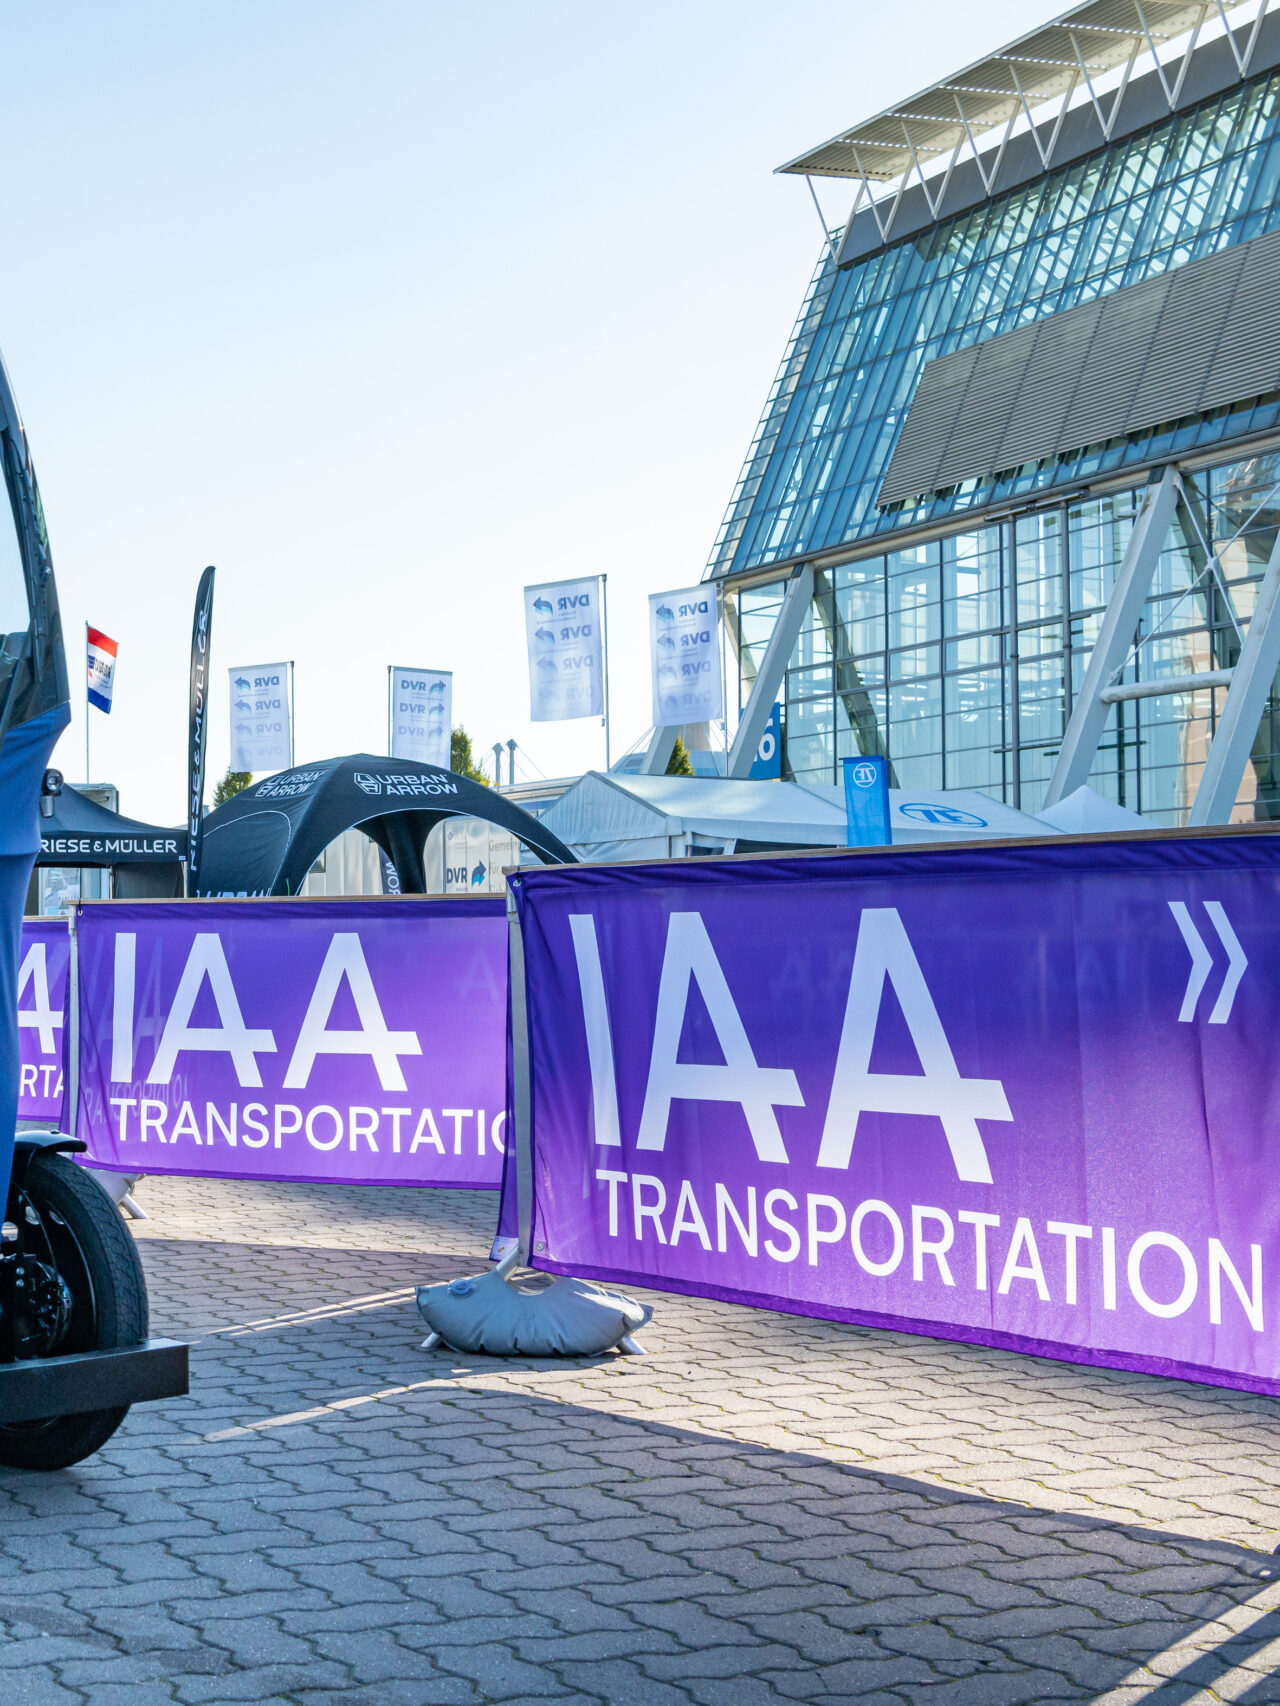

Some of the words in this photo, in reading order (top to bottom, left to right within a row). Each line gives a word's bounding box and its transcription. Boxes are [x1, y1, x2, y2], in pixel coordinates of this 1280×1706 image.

[401, 680, 427, 691] DVR
[399, 703, 426, 714] DVR
[379, 774, 448, 784] URBAN
[267, 782, 315, 797] ARROW
[386, 784, 458, 795] ARROW
[39, 839, 90, 853] RIESE
[93, 841, 104, 852] &
[105, 839, 177, 853] MÜLLER
[446, 867, 468, 884] DVR
[110, 932, 423, 1092] IAA
[568, 907, 1014, 1184] IAA
[595, 1169, 1264, 1332] TRANSPORTATION
